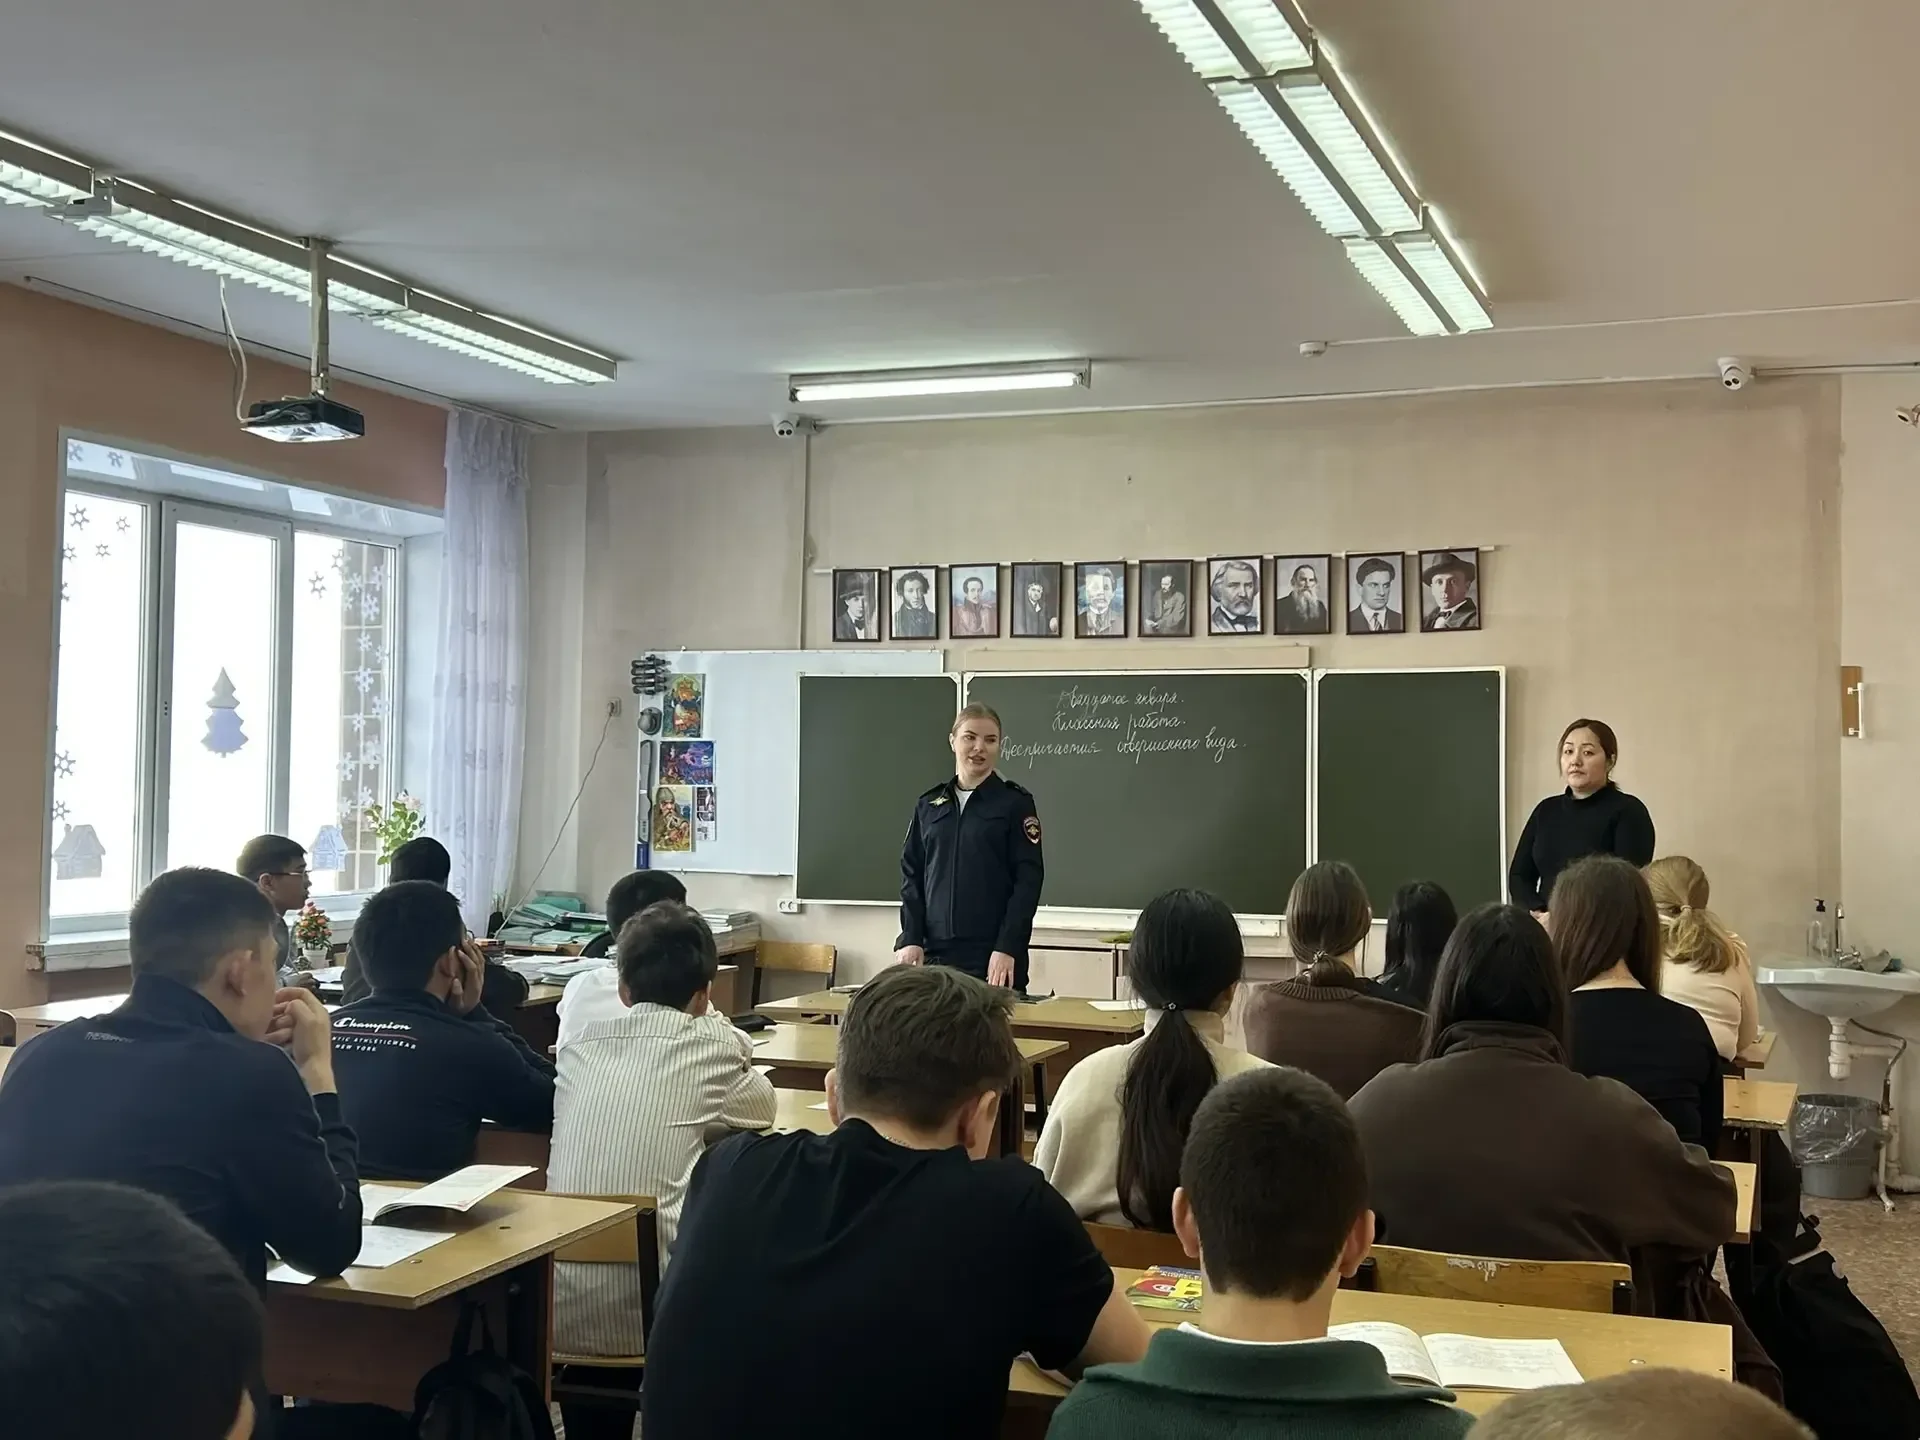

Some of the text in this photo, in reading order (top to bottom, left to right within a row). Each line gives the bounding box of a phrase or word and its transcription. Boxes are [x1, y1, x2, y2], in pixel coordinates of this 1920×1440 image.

[1052, 710, 1120, 732] Классная
[333, 1017, 412, 1033] Champion
[353, 1037, 417, 1050] ATHLETICWEAR
